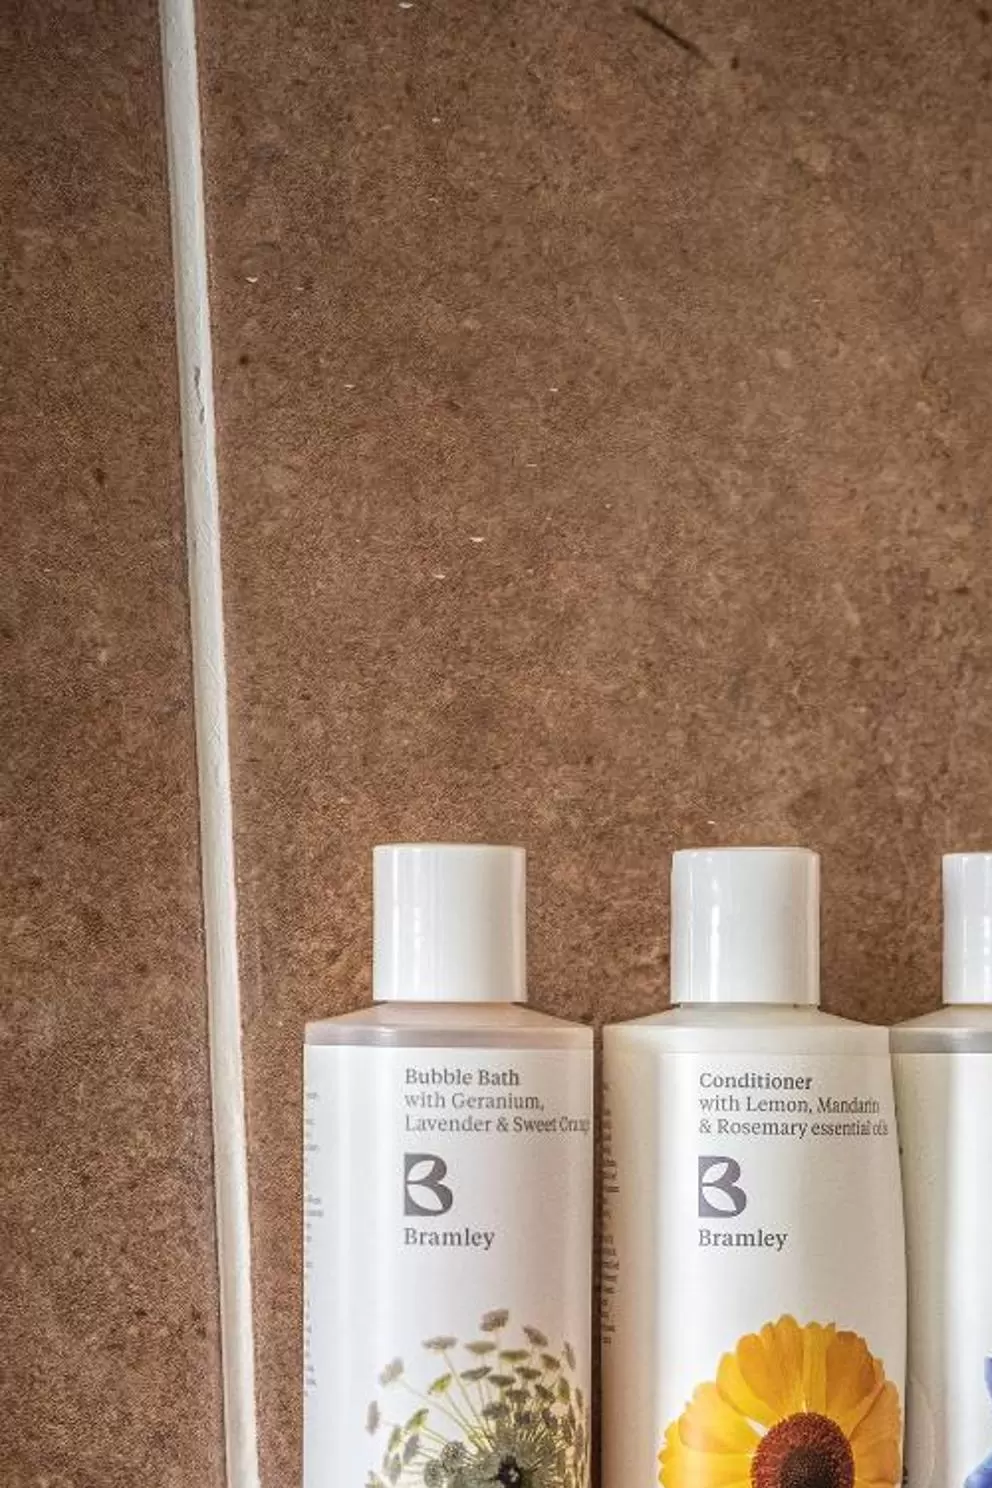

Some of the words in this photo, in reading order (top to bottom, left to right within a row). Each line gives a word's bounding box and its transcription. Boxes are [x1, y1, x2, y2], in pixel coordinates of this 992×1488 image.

[405, 1067, 473, 1086] Bubble
[478, 1068, 520, 1087] Bath
[699, 1073, 812, 1090] Conditioner
[404, 1093, 446, 1110] with
[451, 1093, 545, 1112] Geranium,
[699, 1095, 740, 1112] with
[746, 1097, 813, 1113] Lemon,
[404, 1115, 491, 1133] Lavender
[496, 1116, 510, 1132] &
[513, 1116, 556, 1132] Sweet
[699, 1119, 713, 1136] &
[717, 1119, 806, 1139] Rosemary
[404, 1227, 495, 1250] Bramley
[698, 1229, 789, 1252] Bramley
